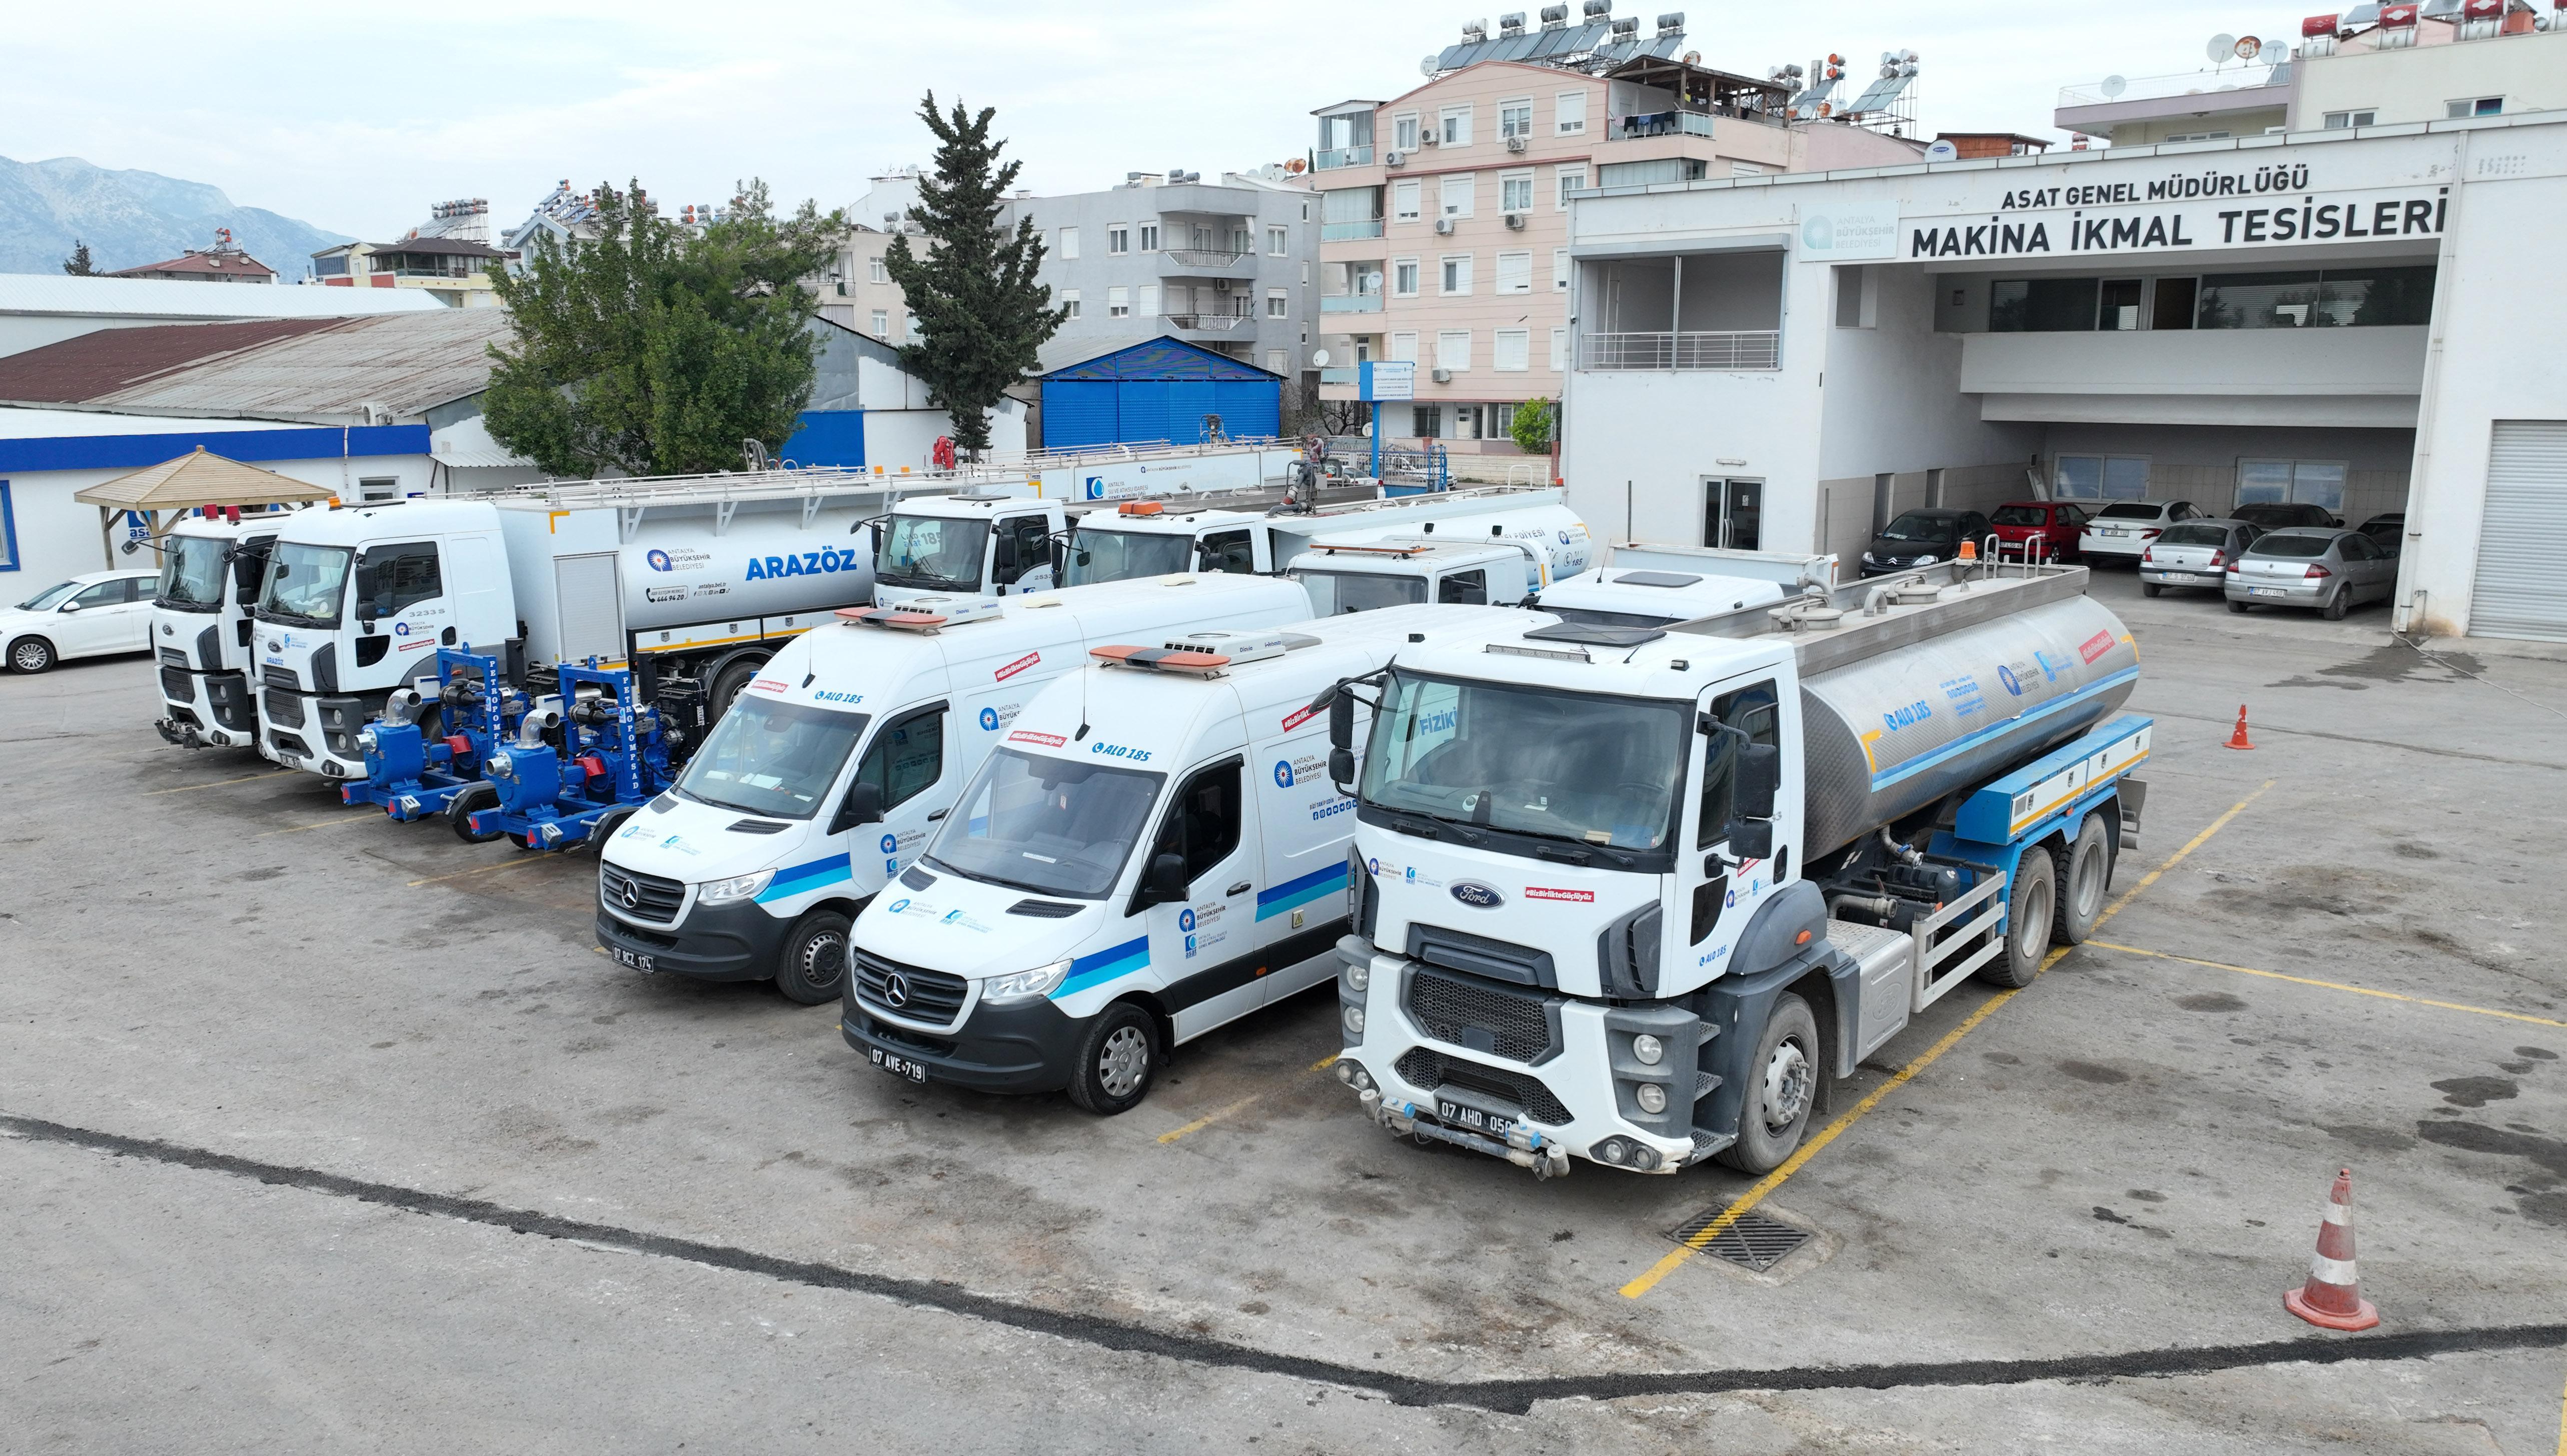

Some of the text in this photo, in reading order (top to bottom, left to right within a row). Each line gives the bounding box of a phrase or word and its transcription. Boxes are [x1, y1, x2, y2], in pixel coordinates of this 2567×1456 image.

[2001, 164, 2309, 209] ASAT GENEL MÜDÜRLÜĞÜ
[1837, 216, 1875, 225] ANTALYA
[1912, 187, 2449, 258] MAKİNA İKMAL TESİSLERİ
[1836, 224, 1895, 237] BÜYÜKŞEHİR
[1835, 238, 1881, 249] BELEDİYESİ
[670, 553, 711, 563] BÜYÜKŞEHİR
[745, 545, 857, 581] ARAZÖZ
[1572, 558, 1583, 567] 185
[672, 562, 705, 571] BELEDİYESİ
[409, 609, 437, 617] 3233
[489, 660, 501, 749] PETROPOMPS
[823, 691, 864, 704] ALO 185
[998, 703, 1020, 712] ANTALYA
[1911, 700, 1932, 721] 185
[1420, 706, 1458, 736] FİZİKİ
[622, 677, 639, 789] PETROPOMPSAD
[1102, 744, 1152, 762] ALO 185
[1293, 754, 1316, 766] ANTALYA
[1294, 760, 1327, 776] BÜYÜKŞEHİR
[1296, 770, 1322, 785] BELEDİYESİ
[1317, 799, 1326, 808] TAKİP
[1326, 797, 1334, 805] EDİN
[896, 829, 916, 838] ANTALYA
[897, 832, 926, 845] BÜYÜKŞEHİR
[1459, 885, 1490, 904] Ford
[1526, 889, 1592, 902] #BizBirlikteGüçlüyüz
[1196, 901, 1216, 913] ANTALYA
[1196, 904, 1226, 920] BÜYÜKŞEHİR
[1197, 914, 1221, 929] BELEDİYESİ
[614, 947, 651, 970] 07 BCZ 174
[1705, 944, 1727, 964] ALO 185
[872, 1049, 922, 1080] 07 AVE 719
[1442, 1101, 1457, 1118] 07
[1460, 1107, 1482, 1126] AHD
